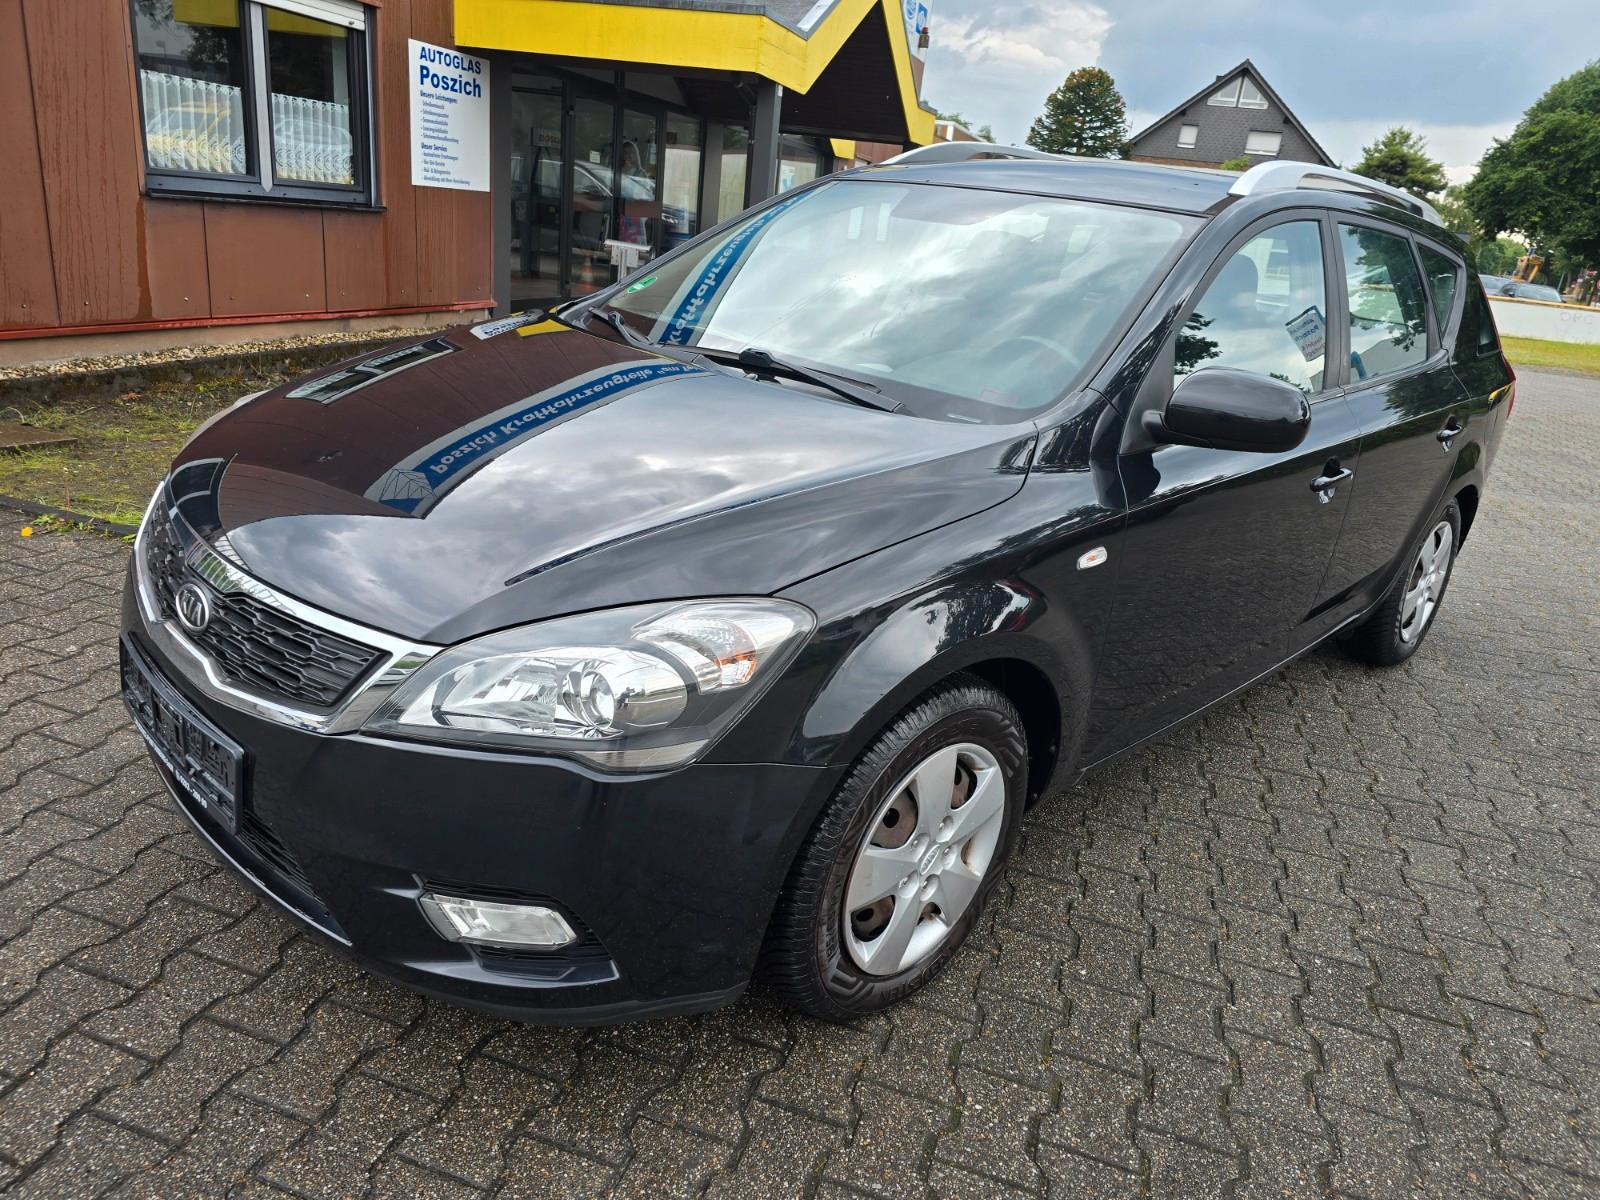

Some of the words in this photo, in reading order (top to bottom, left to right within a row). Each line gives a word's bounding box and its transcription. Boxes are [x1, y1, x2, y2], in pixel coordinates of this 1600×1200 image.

[419, 46, 481, 74] AUTOGLAS
[419, 65, 481, 98] Poszich
[179, 588, 205, 627] KIA
